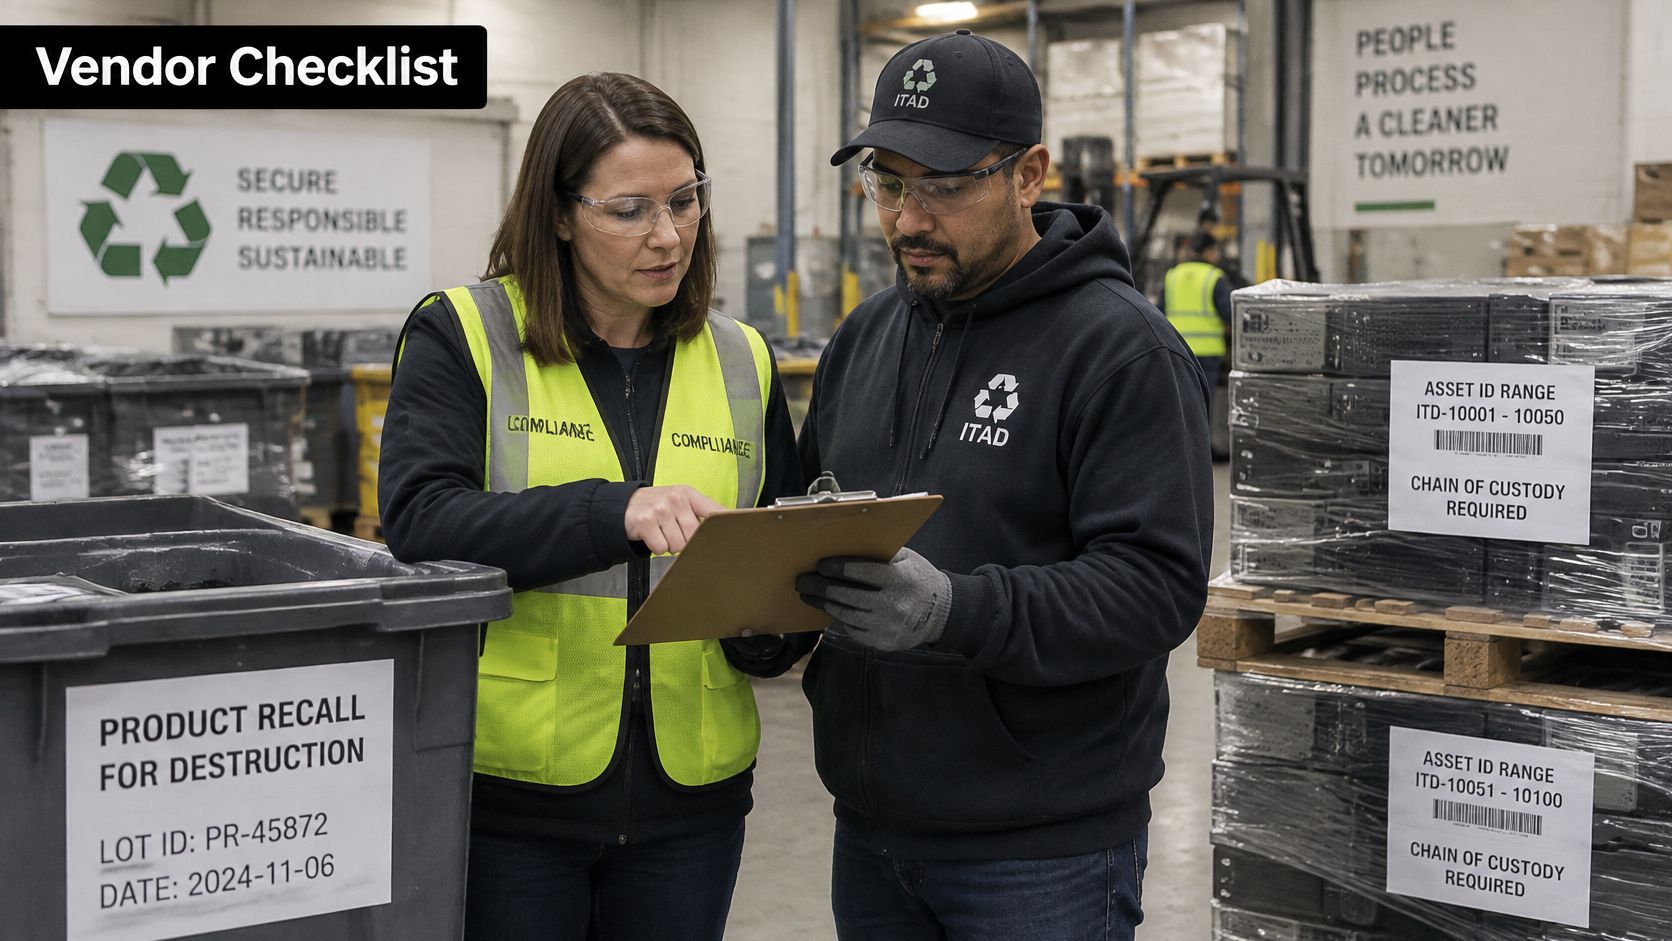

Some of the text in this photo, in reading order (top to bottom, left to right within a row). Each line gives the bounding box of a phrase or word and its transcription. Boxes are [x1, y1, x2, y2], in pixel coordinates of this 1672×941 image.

[1355, 21, 1456, 57] PEOPLE
[1355, 63, 1477, 97] PROCESS
[894, 93, 929, 109] ITAD
[1354, 104, 1499, 138] A CLEANER
[1355, 147, 1509, 178] TOMORROW
[237, 167, 338, 195] SECURE
[237, 207, 407, 233] RESPONSIBLE
[237, 245, 407, 271] SUSTAINABLE
[1424, 381, 1556, 401] ASSET ID RANGE
[1416, 404, 1495, 423] ITD-10001
[1514, 408, 1564, 425] 10050
[959, 422, 1010, 447] ITAD
[1411, 476, 1566, 500] CHAIN OF CUSTODY
[1446, 500, 1527, 521] REQUIRED
[100, 694, 366, 747] PRODUCT RECALL
[100, 736, 365, 791] FOR DESTRUCTION
[1423, 750, 1555, 784] ASSET ID RANGE
[1415, 771, 1494, 798] ITD-10051
[1513, 787, 1563, 809] 10100
[100, 812, 328, 865] LOT ID: PR-45872
[1410, 841, 1565, 882] CHAIN OF CUSTODY
[100, 853, 335, 909] DATE: 2024-11-06
[1445, 869, 1526, 898] REQUIRED
